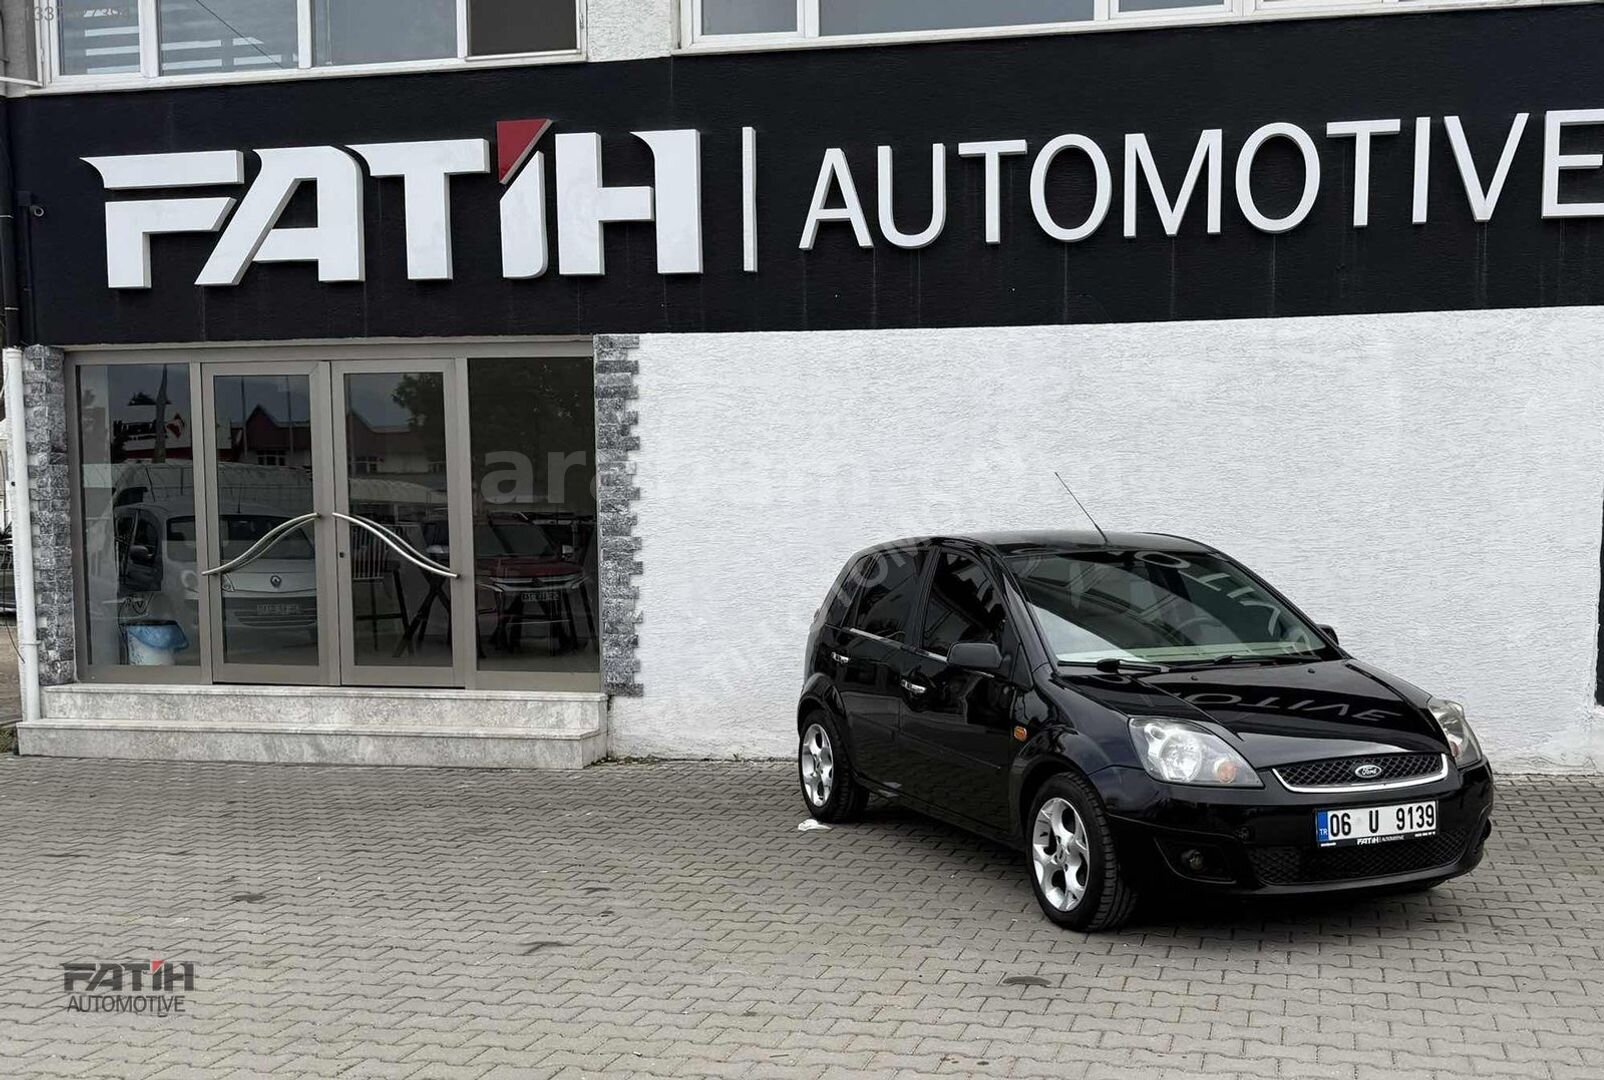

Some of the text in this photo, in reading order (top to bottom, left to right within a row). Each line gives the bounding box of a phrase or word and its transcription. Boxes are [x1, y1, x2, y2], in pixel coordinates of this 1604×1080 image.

[798, 108, 1604, 250] AUTOMOTIVE
[1358, 765, 1379, 777] Ford
[1330, 803, 1435, 837] 06 U 9139
[1320, 828, 1328, 836] TR
